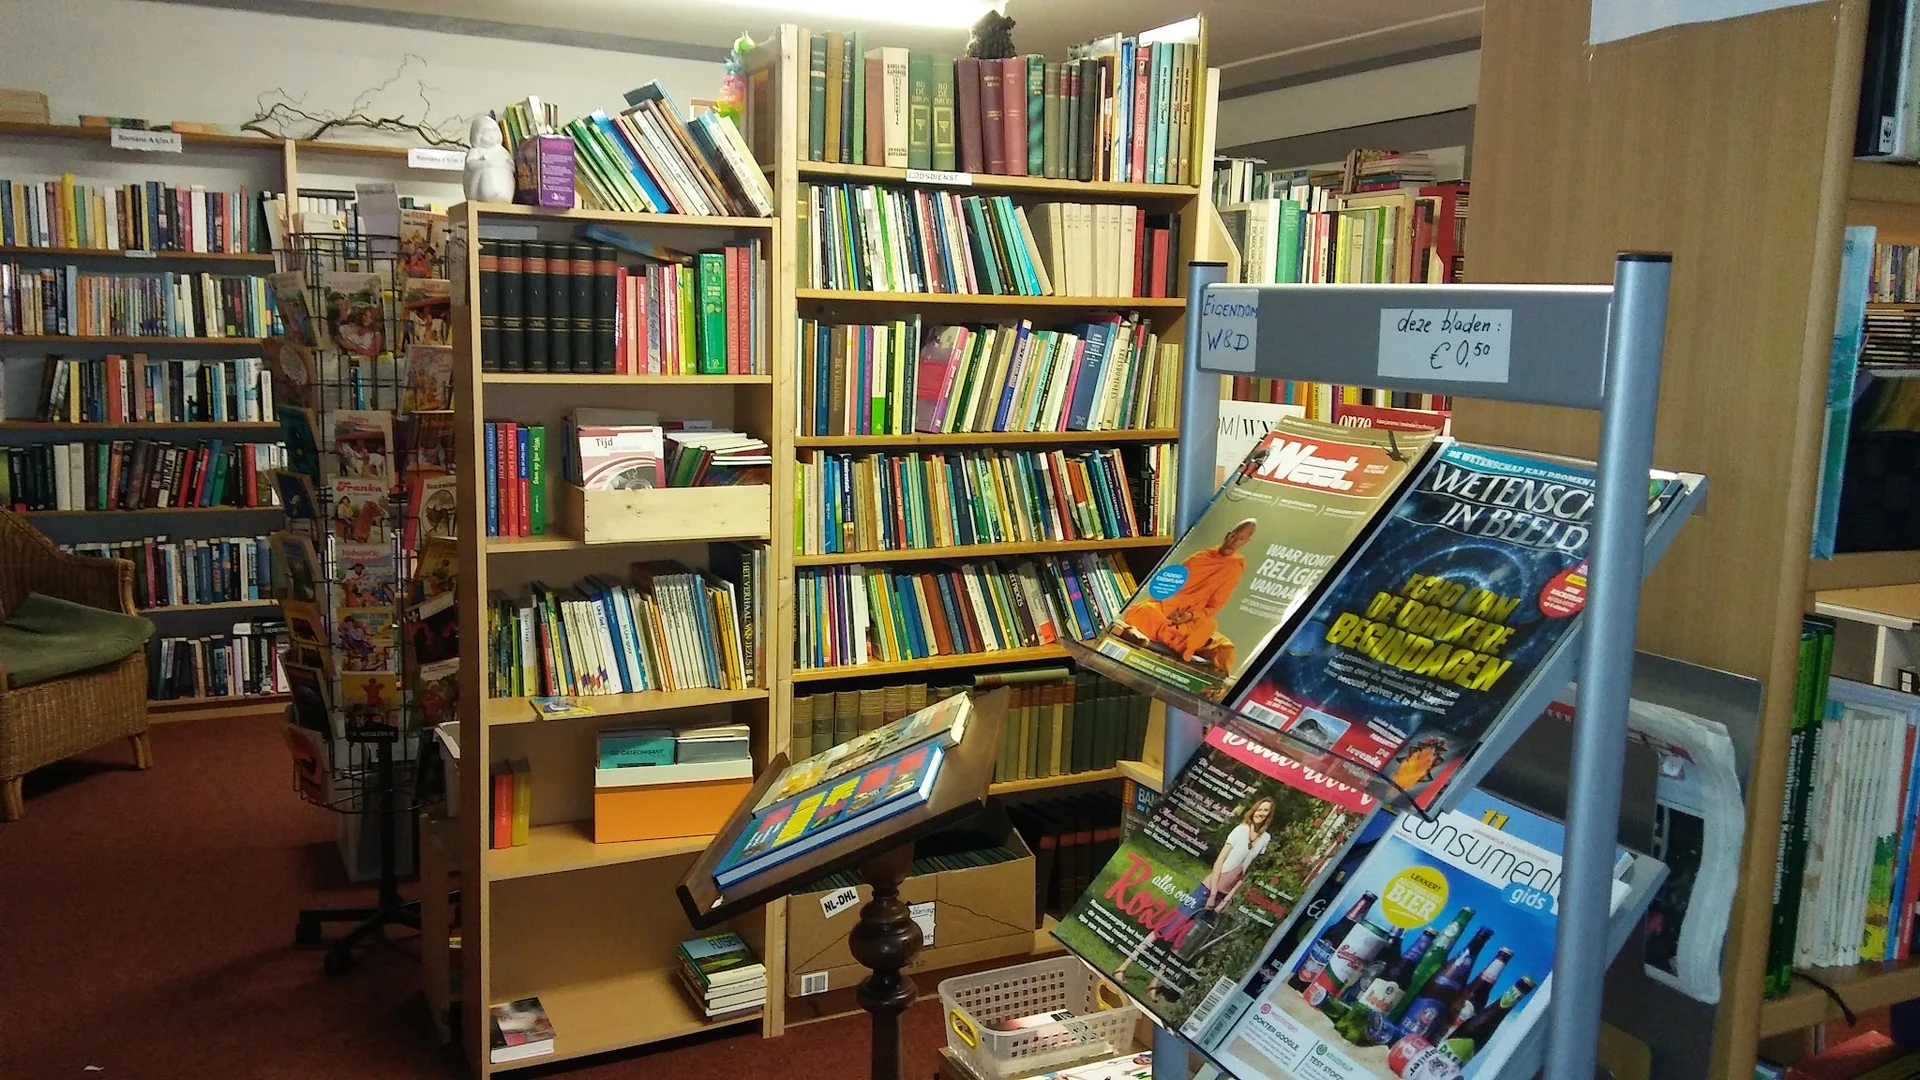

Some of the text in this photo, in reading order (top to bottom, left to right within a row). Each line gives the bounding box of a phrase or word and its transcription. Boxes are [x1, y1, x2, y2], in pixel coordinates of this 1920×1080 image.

[908, 171, 959, 183] GODSDIENST
[1397, 316, 1432, 333] deze
[1207, 330, 1249, 351] W&D
[595, 438, 613, 448] Tijd
[532, 452, 540, 462] mij
[533, 462, 541, 471] de
[1460, 452, 1525, 473] WETENSCHAP
[1525, 466, 1545, 478] KAN
[1546, 469, 1588, 485] DROMEN
[532, 471, 540, 485] weg
[1440, 503, 1591, 550] IN BEELD
[1267, 544, 1334, 567] WAAR KOMT
[1257, 559, 1323, 587] RELIGIE
[1011, 582, 1023, 606] PROCES
[1402, 573, 1460, 608] ECHO
[1463, 588, 1521, 619] VAN
[741, 561, 752, 667] HET VERHAAL VAN JEZUS
[1364, 591, 1516, 656] DE DONKERE
[1326, 612, 1513, 692] BEGINDAGEN
[1365, 682, 1395, 699] golven
[1432, 685, 1461, 699] weten
[1343, 744, 1385, 768] levende
[1196, 756, 1211, 767] De
[1233, 779, 1247, 789] een
[1243, 784, 1257, 796] pot
[1216, 788, 1234, 800] balkon
[1156, 804, 1202, 835] Mannenwerk
[1772, 734, 1799, 905] Groenblijvende Kamerplanten
[1149, 813, 1211, 852] op de Oosterschelde
[1150, 831, 1177, 851] Nederland
[1149, 869, 1201, 910] alles over
[1410, 871, 1442, 893] LEKKER?
[823, 890, 856, 913] NL-DHL
[1105, 852, 1196, 950] Rozen
[1386, 885, 1438, 922] BIER
[1509, 886, 1548, 910] gids
[1076, 913, 1089, 925] tips
[1087, 898, 1128, 930] Rozenverzorging
[1093, 913, 1114, 931] mooiste
[1253, 1014, 1277, 1034] DOKTER
[1275, 1031, 1300, 1052] GOOGLE
[1309, 1055, 1325, 1068] TEST
